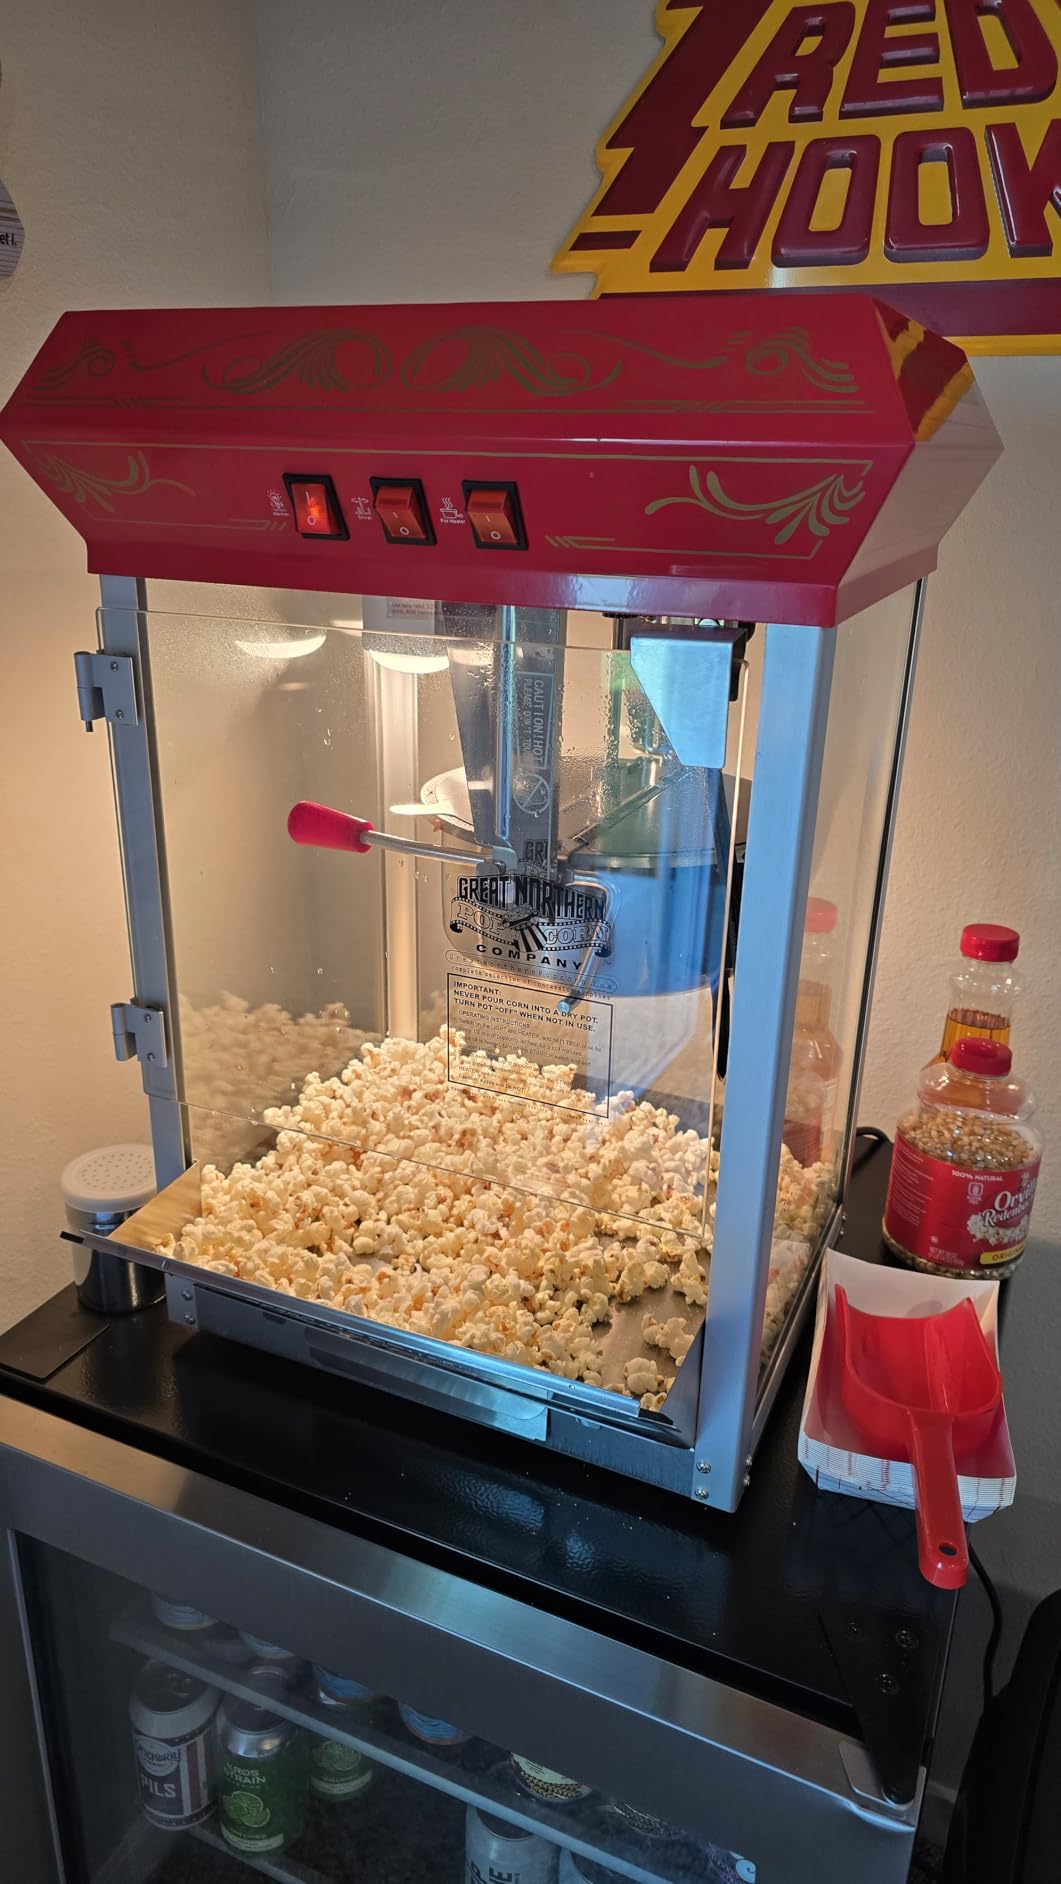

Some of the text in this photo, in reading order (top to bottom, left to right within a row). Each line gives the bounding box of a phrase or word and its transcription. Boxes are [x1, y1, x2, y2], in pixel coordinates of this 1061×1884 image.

[720, 0, 1058, 129] RED
[523, 679, 532, 707] PLEASE
[458, 875, 608, 920] GREAT NORTHERN
[457, 902, 609, 945] POP CORN
[476, 944, 583, 971] COMPANY
[453, 980, 501, 995] IMPORTANT:
[453, 989, 480, 1000] NEVER
[482, 994, 504, 1004] POUR
[506, 999, 528, 1010] CORN
[531, 1004, 550, 1014] INTO
[561, 1010, 577, 1019] DRY
[580, 1014, 598, 1024] POT.
[454, 997, 475, 1007] TURN
[477, 1002, 492, 1011] POT
[519, 1010, 543, 1021] WHEN
[545, 1016, 562, 1025] NOT
[576, 1022, 596, 1032] USE.
[458, 1009, 489, 1020] OPERATING
[951, 1169, 973, 1180] 100%
[140, 1774, 177, 1799] PILS
